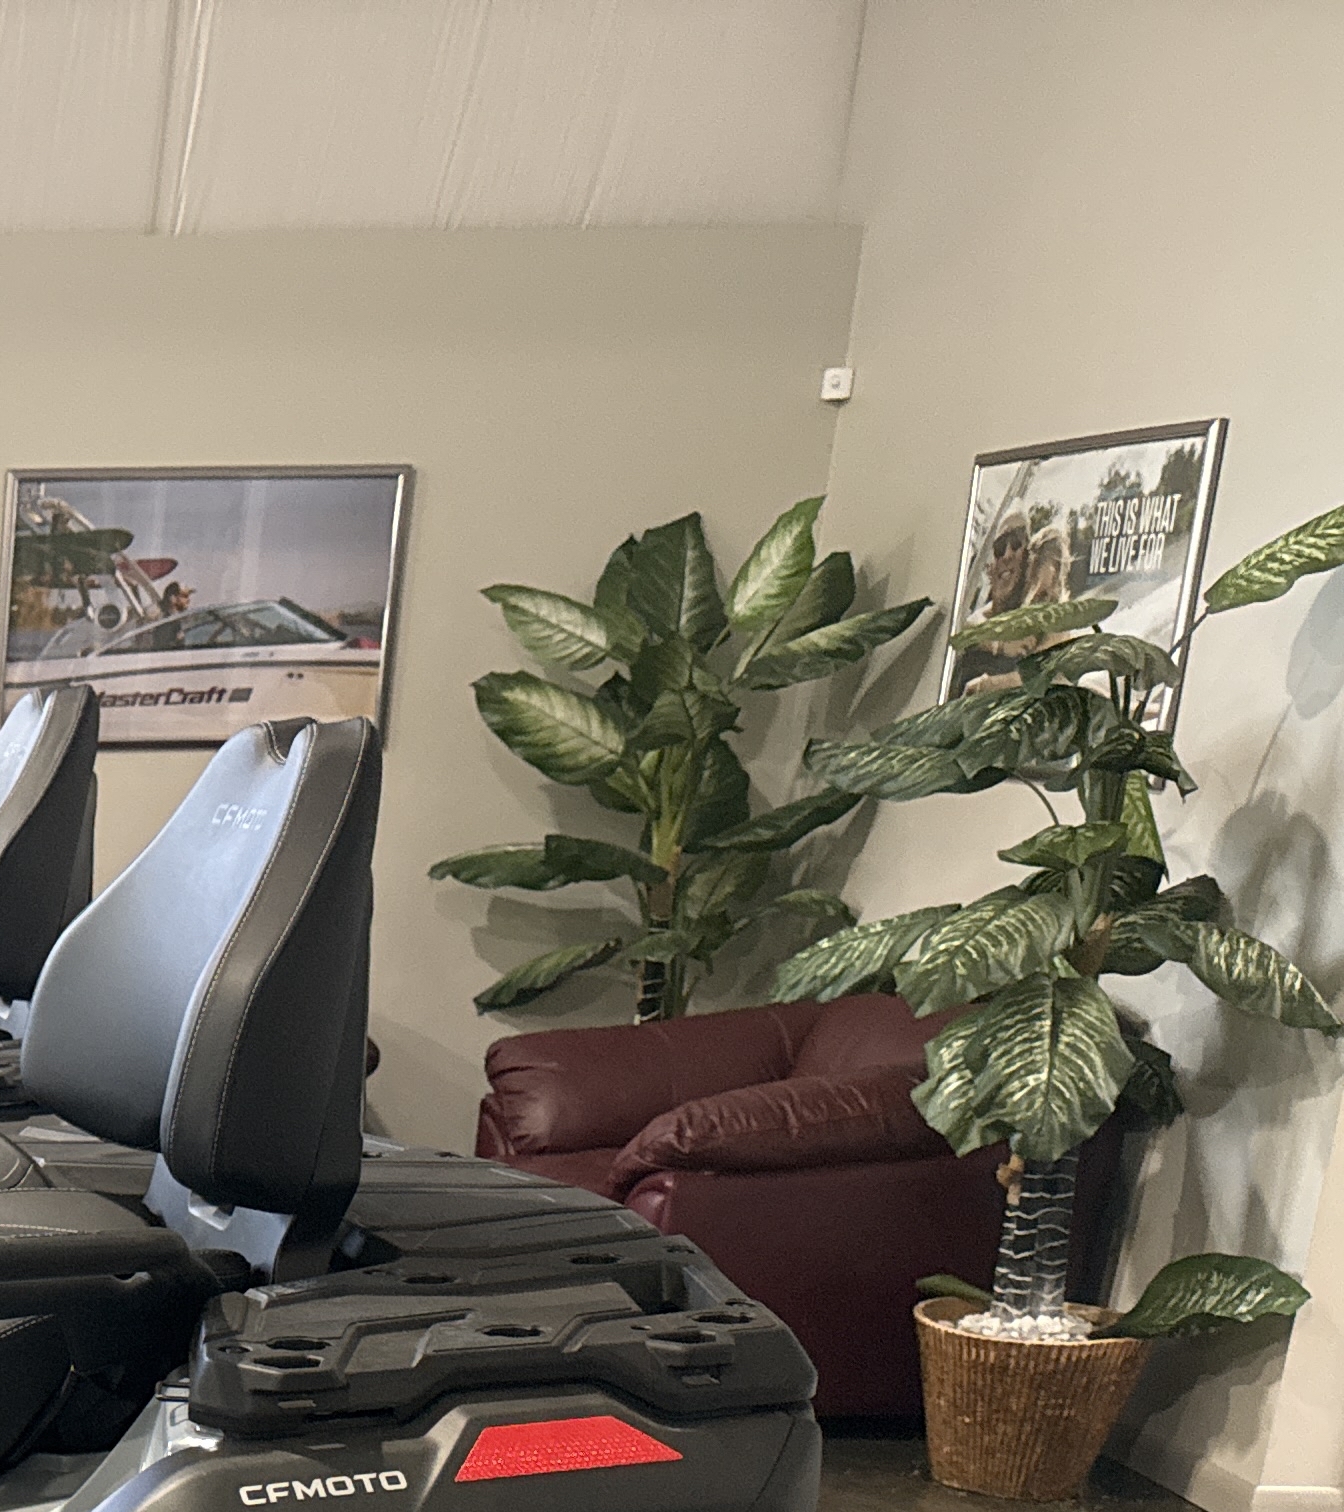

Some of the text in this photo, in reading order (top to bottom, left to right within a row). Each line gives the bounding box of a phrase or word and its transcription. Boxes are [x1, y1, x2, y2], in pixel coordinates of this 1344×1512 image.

[1094, 493, 1182, 537] THIS IS WHAT
[1089, 533, 1166, 574] WE LIVE FOR
[238, 1469, 409, 1506] CFMOTO
